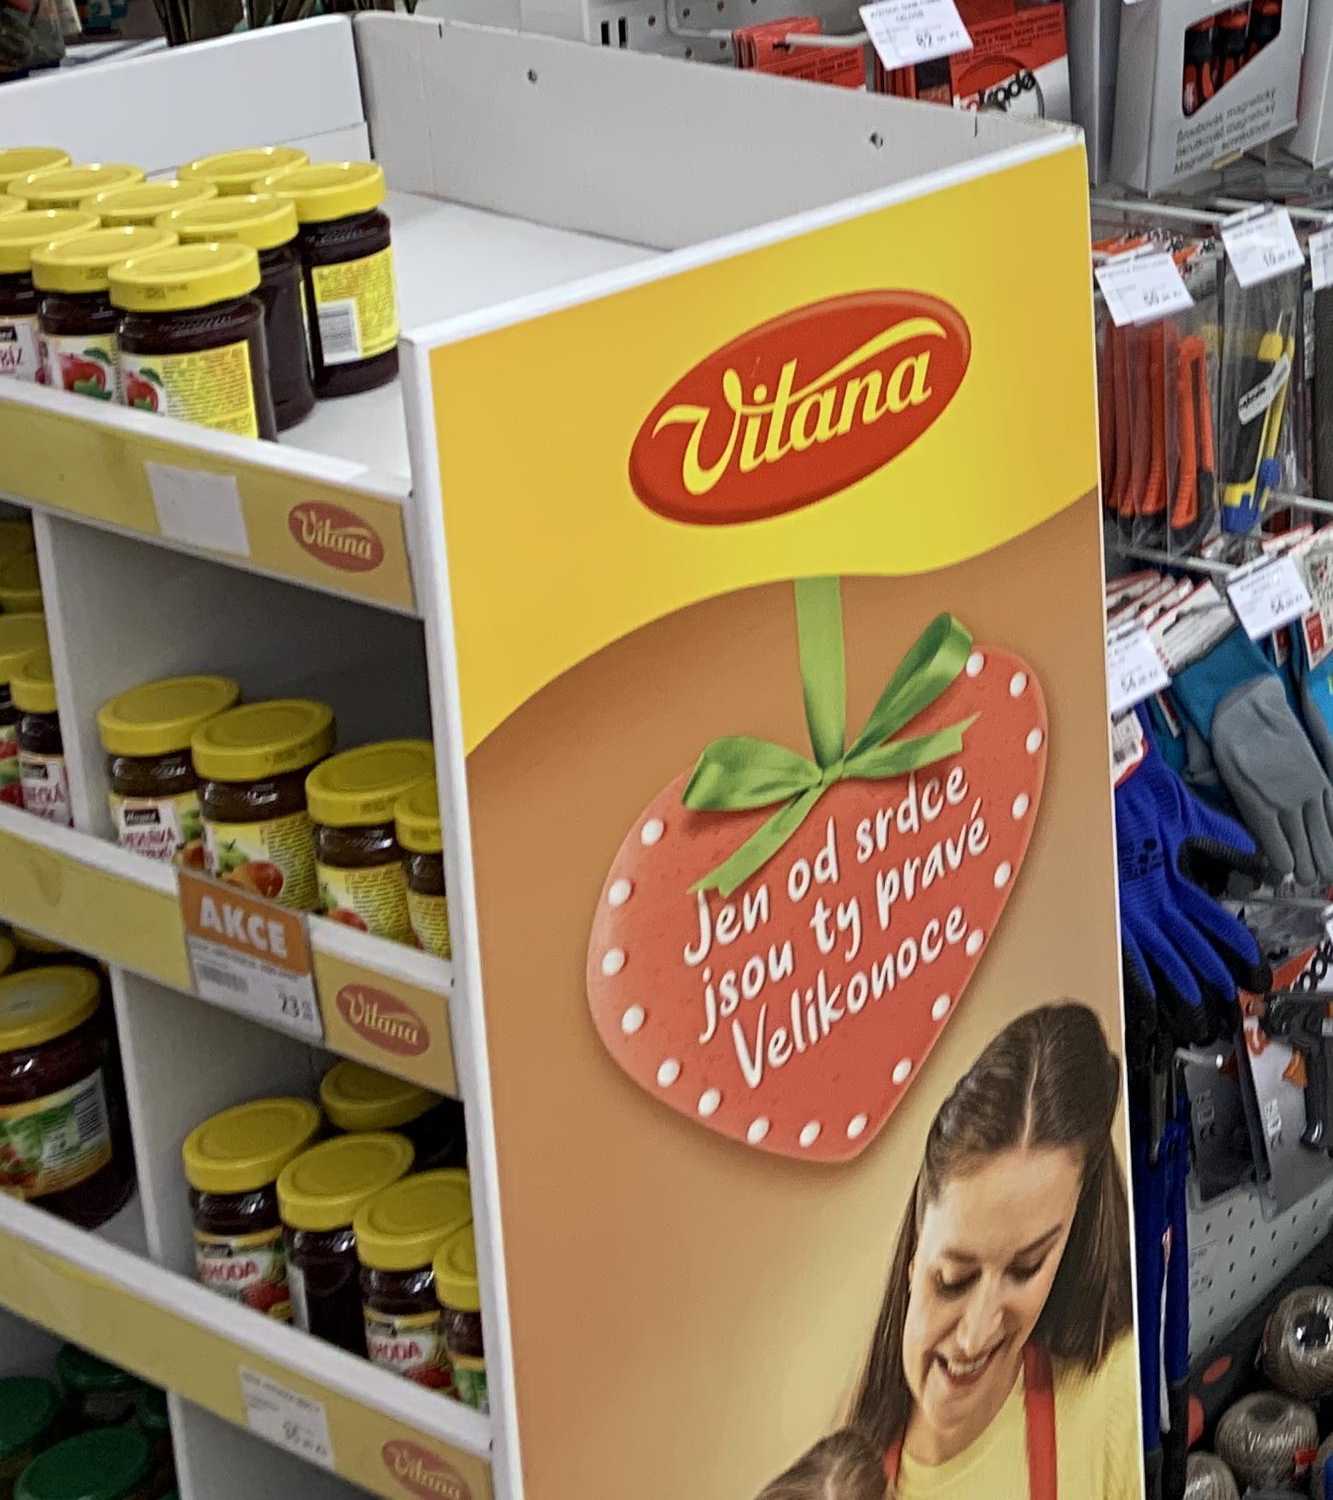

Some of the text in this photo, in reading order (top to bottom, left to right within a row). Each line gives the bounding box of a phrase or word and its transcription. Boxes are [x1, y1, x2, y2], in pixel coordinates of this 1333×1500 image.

[652, 316, 947, 496] Vitana
[201, 898, 288, 959] AKCE
[684, 766, 968, 966] Jen od srdce
[700, 799, 990, 1045] jsou ty pravé
